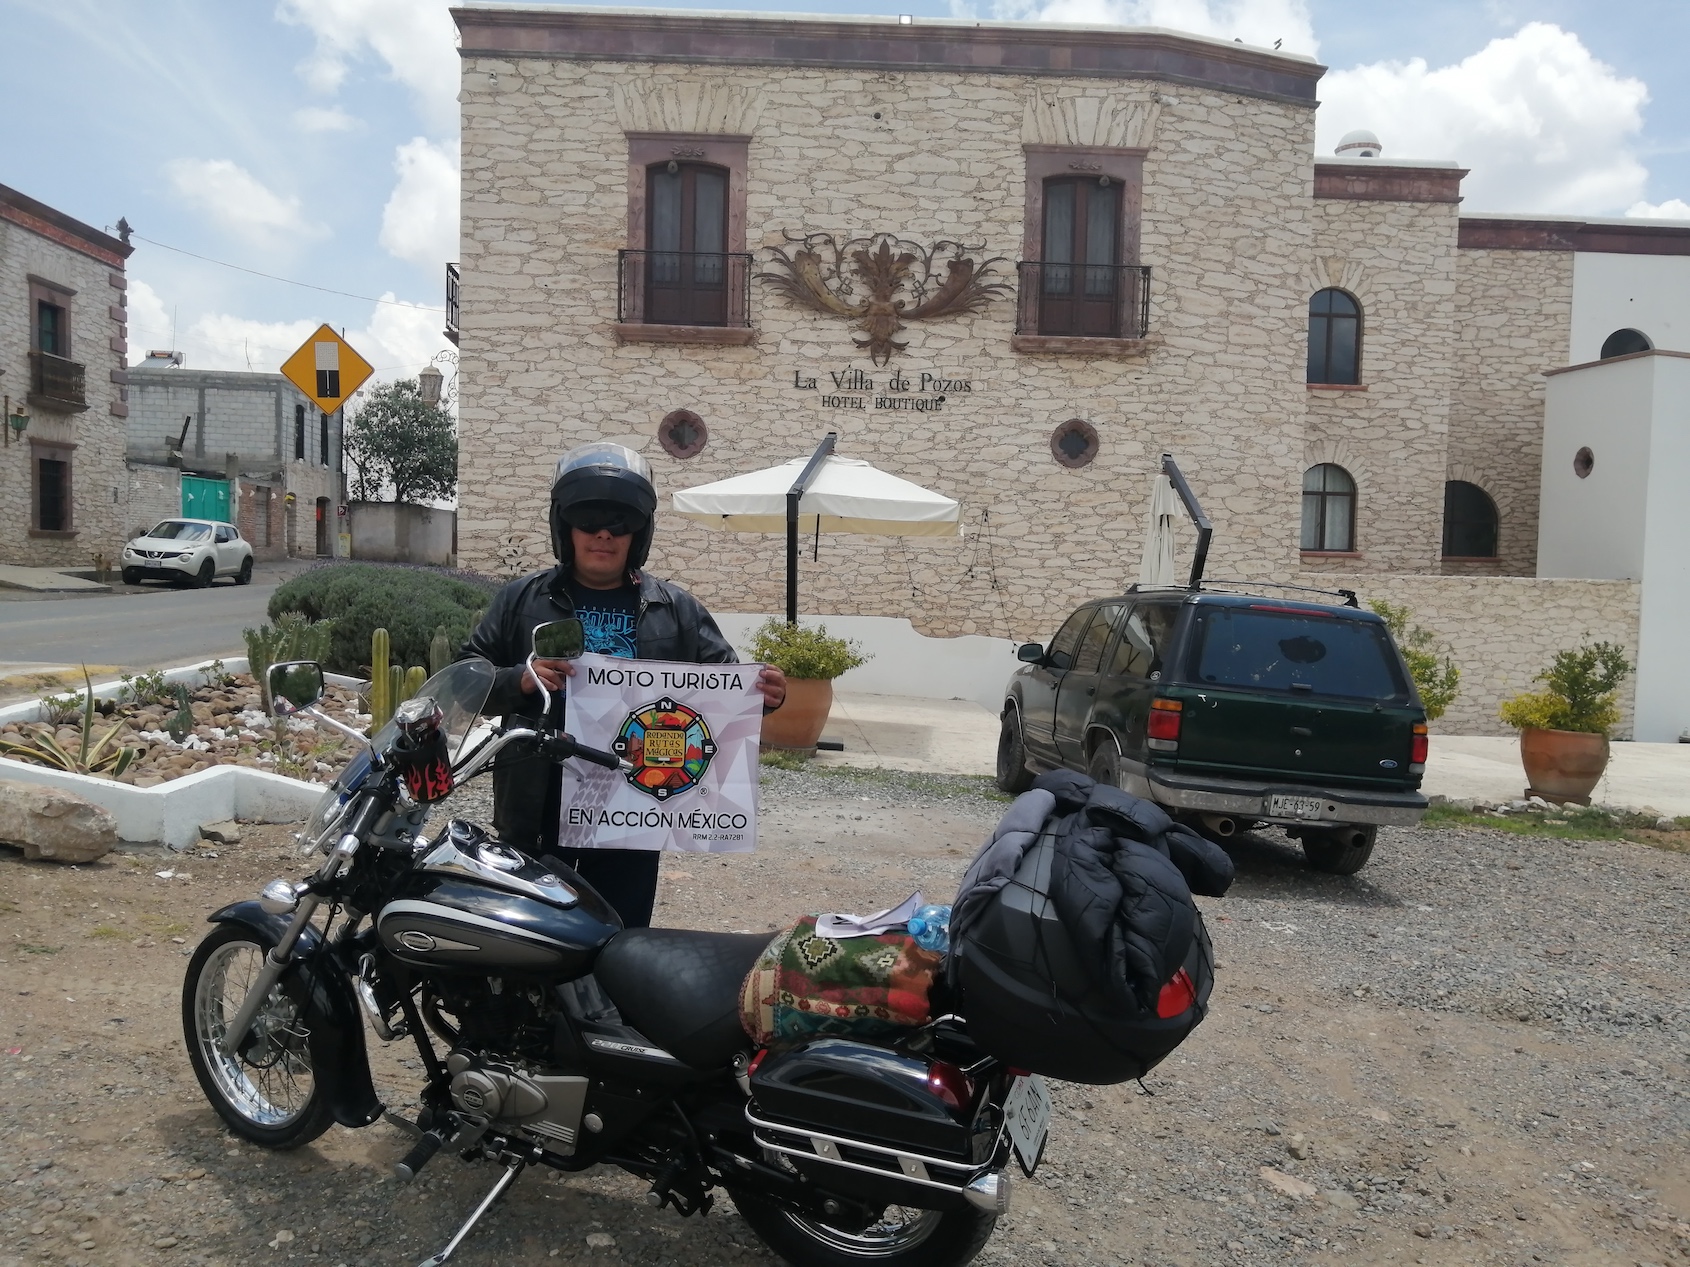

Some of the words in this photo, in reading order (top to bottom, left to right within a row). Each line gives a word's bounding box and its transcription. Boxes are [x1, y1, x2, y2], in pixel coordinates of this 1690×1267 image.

[794, 370, 817, 389] La
[830, 368, 873, 390] Villa
[889, 370, 911, 391] de
[919, 372, 972, 392] Pozos
[821, 395, 866, 409] HOTEL
[875, 397, 943, 412] BOUTIQUE
[588, 667, 654, 688] MOTO
[660, 671, 743, 690] TURISTA
[661, 701, 672, 710] N
[614, 742, 626, 750] O
[704, 745, 714, 753] E
[657, 788, 668, 797] S
[568, 808, 593, 826] EN
[597, 807, 674, 829] ACCIÓN
[678, 808, 747, 829] MÉXICO
